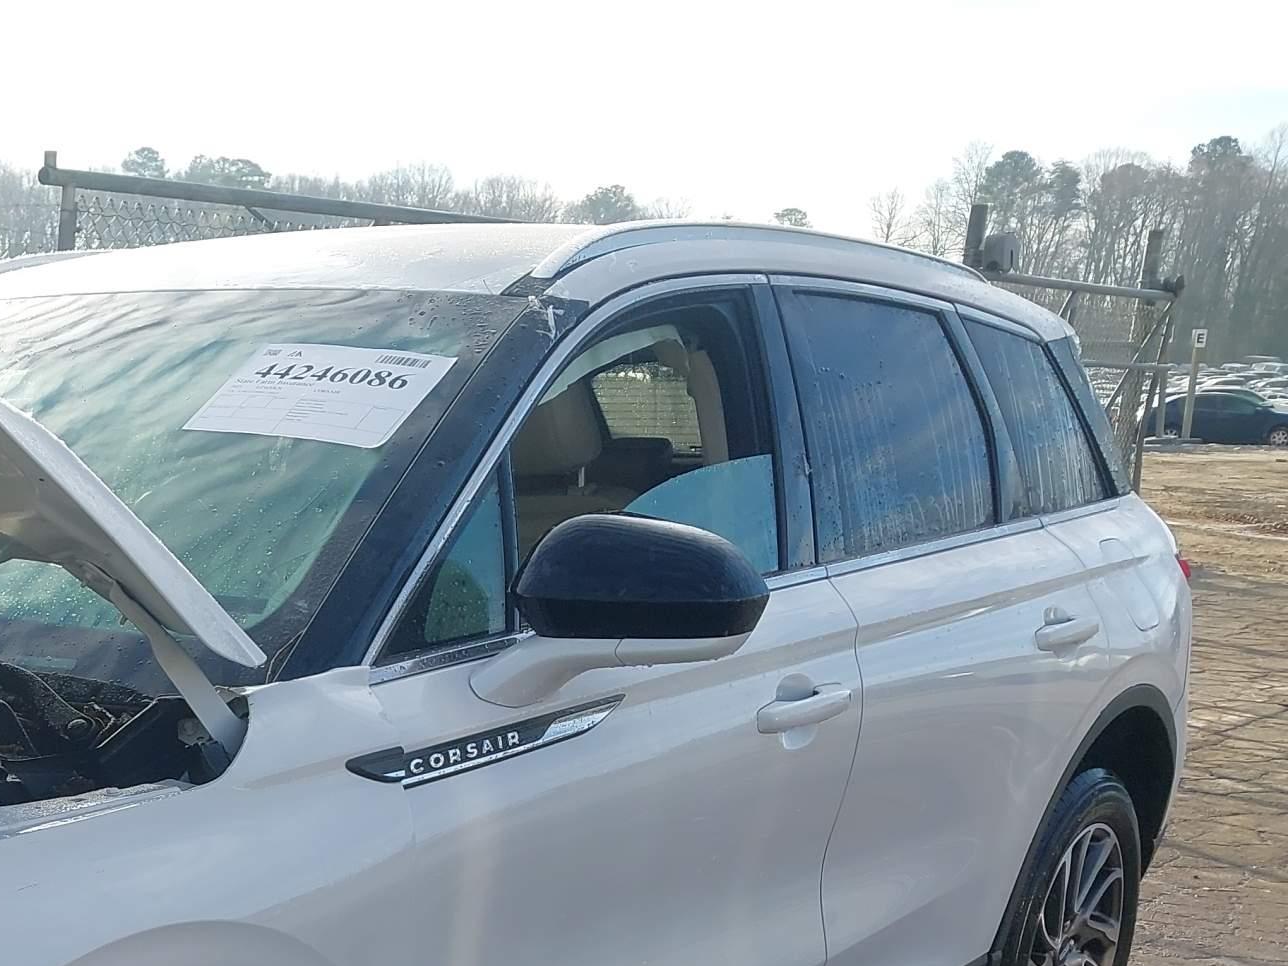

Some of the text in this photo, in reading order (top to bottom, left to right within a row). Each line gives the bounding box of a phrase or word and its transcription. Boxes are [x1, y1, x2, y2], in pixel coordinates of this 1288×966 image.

[1197, 333, 1205, 344] E
[255, 362, 416, 390] 44246086
[409, 731, 520, 774] CORSAIR
